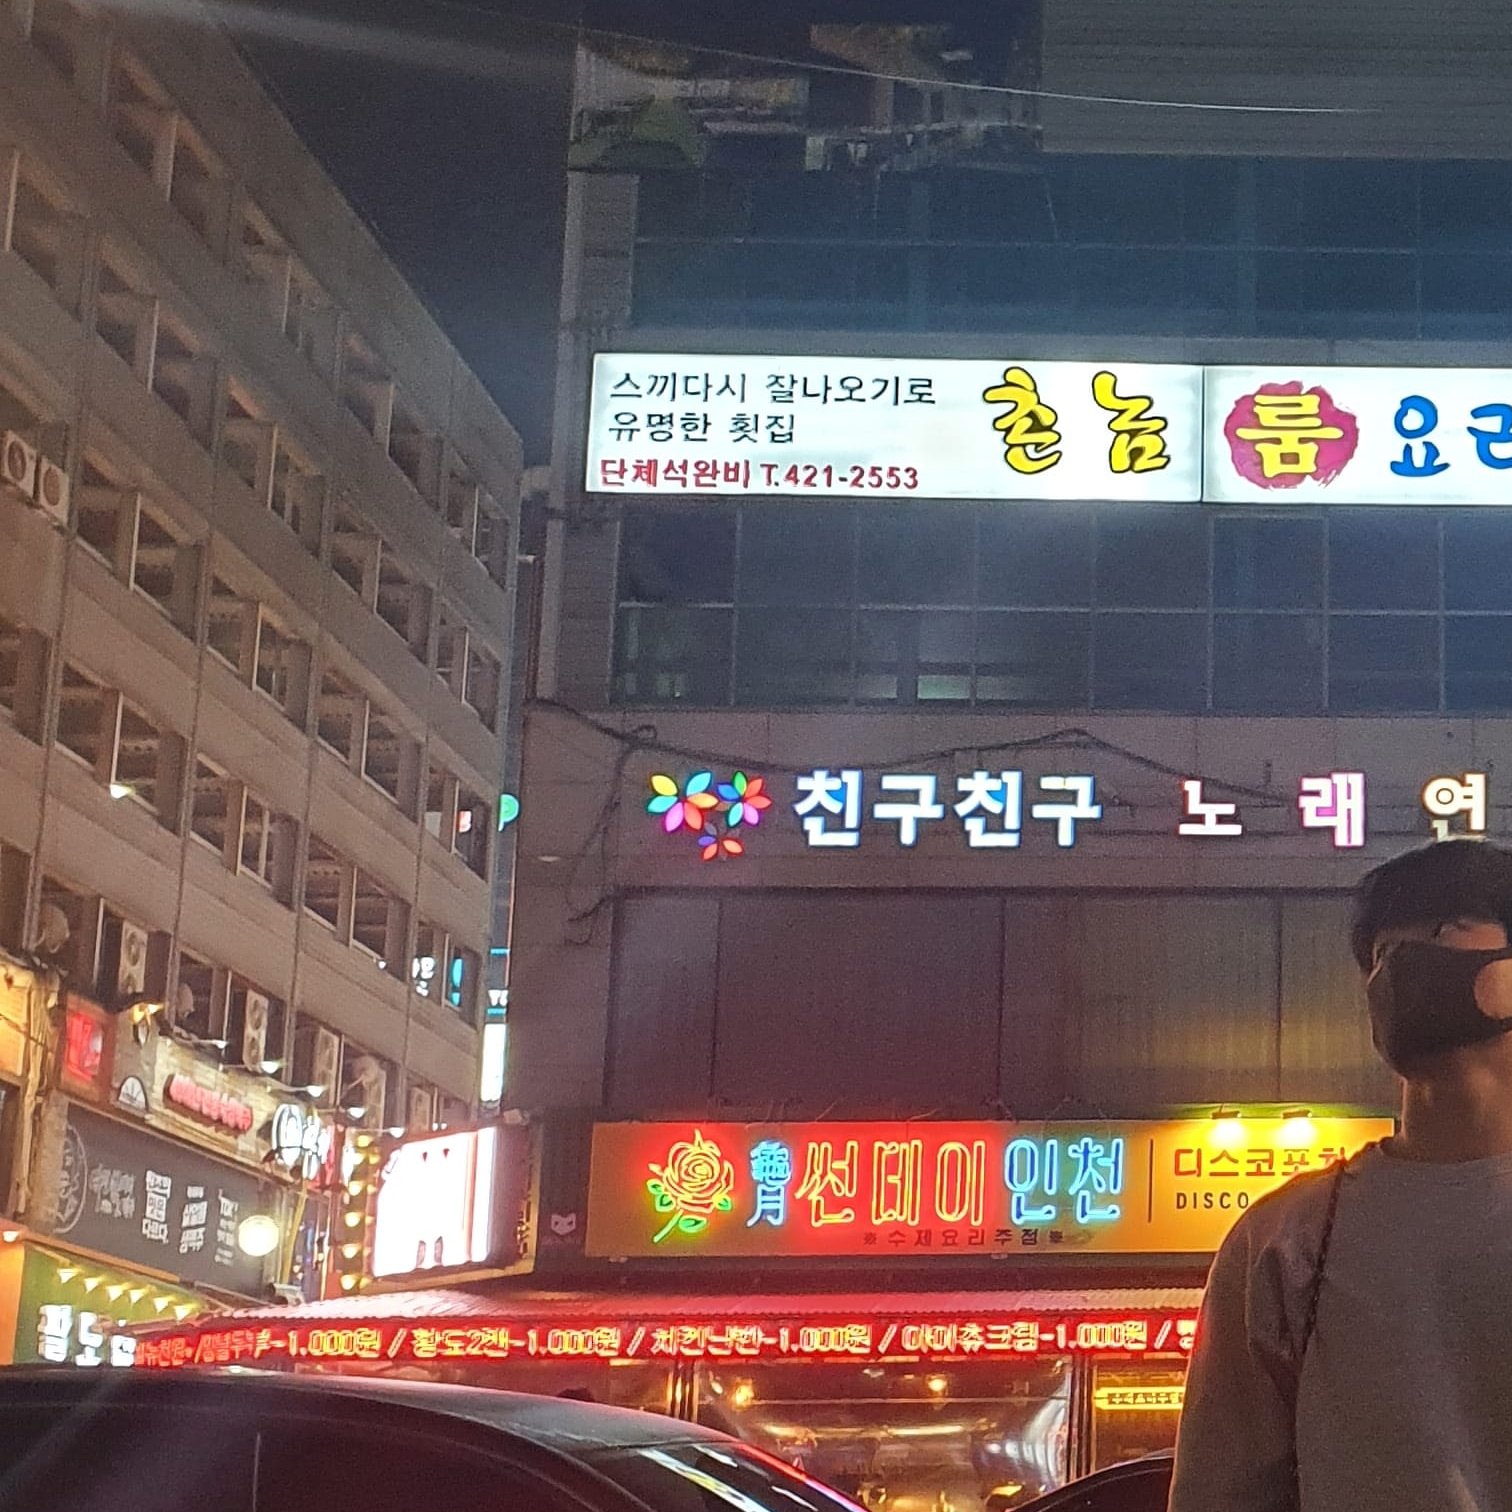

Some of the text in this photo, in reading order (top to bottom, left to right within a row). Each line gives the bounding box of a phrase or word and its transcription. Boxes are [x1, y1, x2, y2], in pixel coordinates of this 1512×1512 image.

[609, 372, 937, 406] 스끼다시 잘나오기로
[608, 411, 796, 444] 유명한 횟집
[1235, 394, 1343, 478] 룸
[599, 458, 919, 491] 단체석완비 T.421-2553
[793, 768, 1102, 848] 친구친구
[1004, 1138, 1125, 1226] 인천
[1176, 1191, 1249, 1210] DISCO
